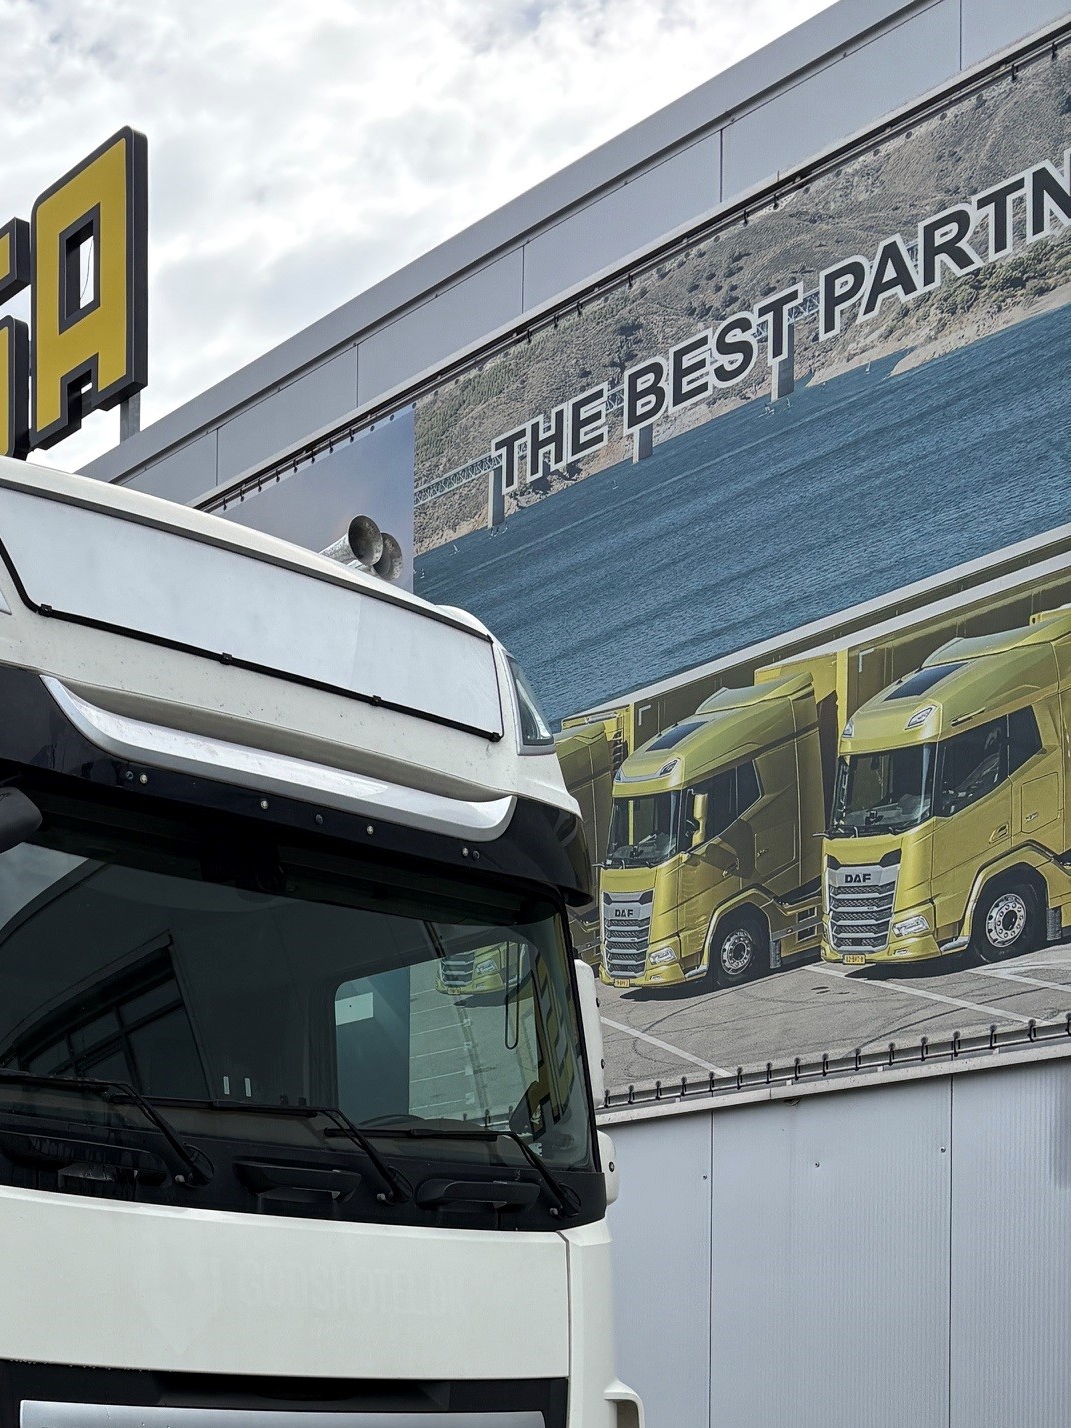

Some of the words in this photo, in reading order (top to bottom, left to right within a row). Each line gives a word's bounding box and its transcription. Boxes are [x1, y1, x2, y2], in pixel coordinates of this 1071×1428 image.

[492, 389, 609, 494] THE
[625, 284, 804, 432] BEST
[820, 150, 1071, 340] PARTN
[844, 873, 872, 884] DAF
[614, 909, 634, 917] DAF
